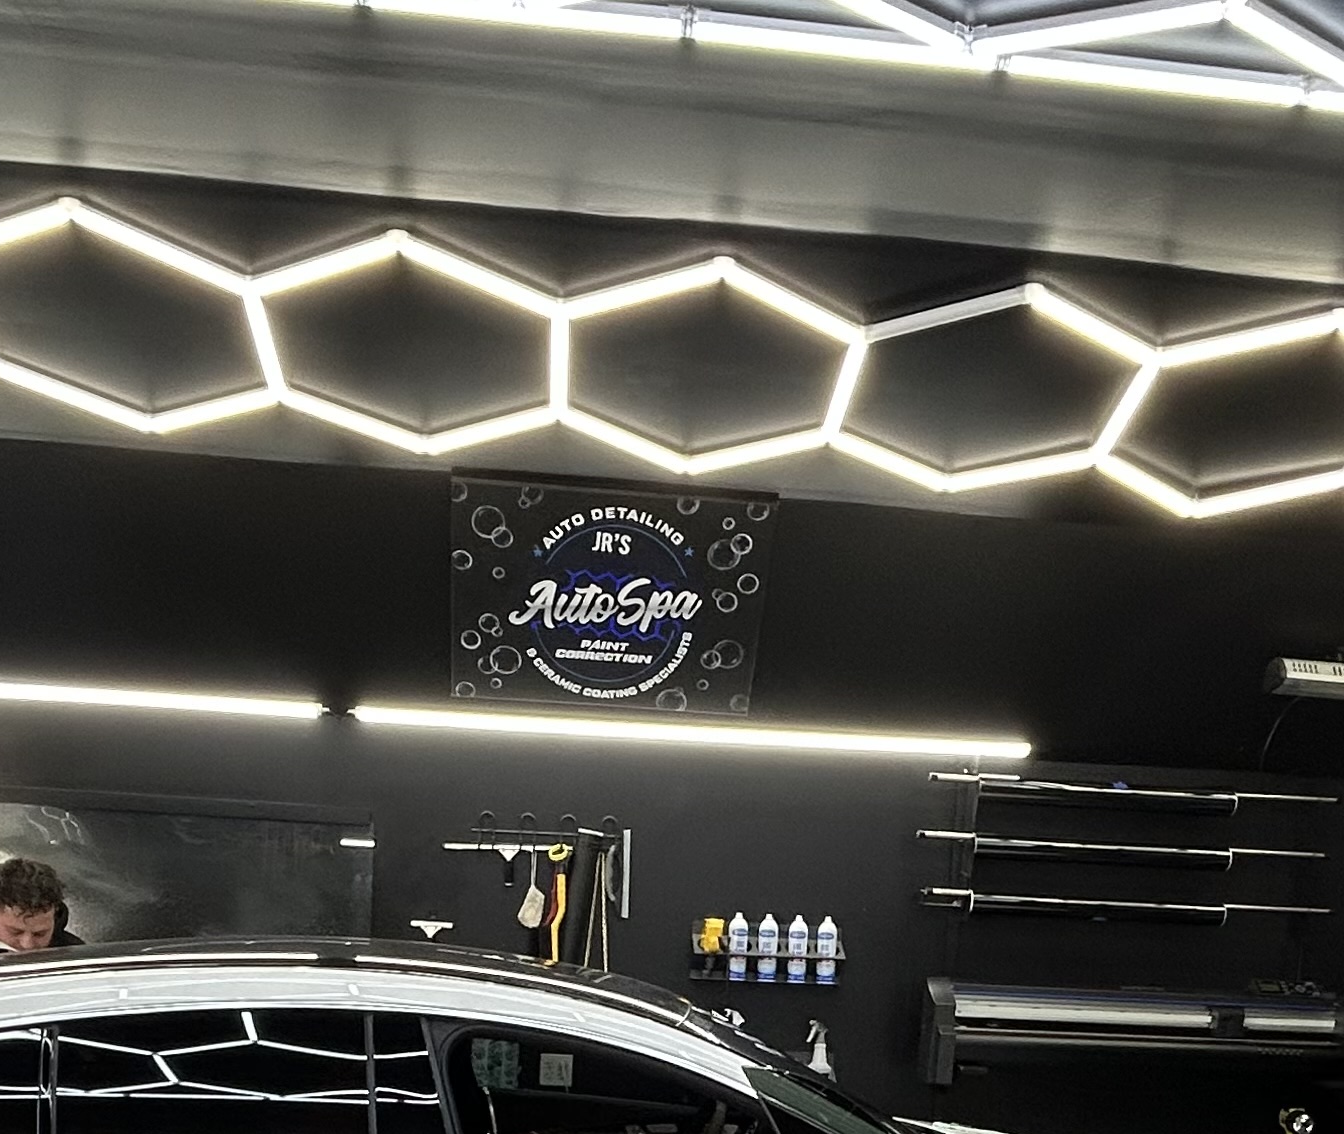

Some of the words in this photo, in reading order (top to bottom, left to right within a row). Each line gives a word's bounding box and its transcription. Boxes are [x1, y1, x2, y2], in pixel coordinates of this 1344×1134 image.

[542, 513, 585, 549] AUTO
[590, 506, 685, 546] DETAILING
[591, 531, 632, 556] JR'S
[554, 648, 653, 665] CORRECTION
[580, 639, 629, 651] PAINT
[532, 657, 582, 694] CERAMIC
[582, 686, 638, 699] COATING
[638, 631, 693, 692] SPECIALISTS
